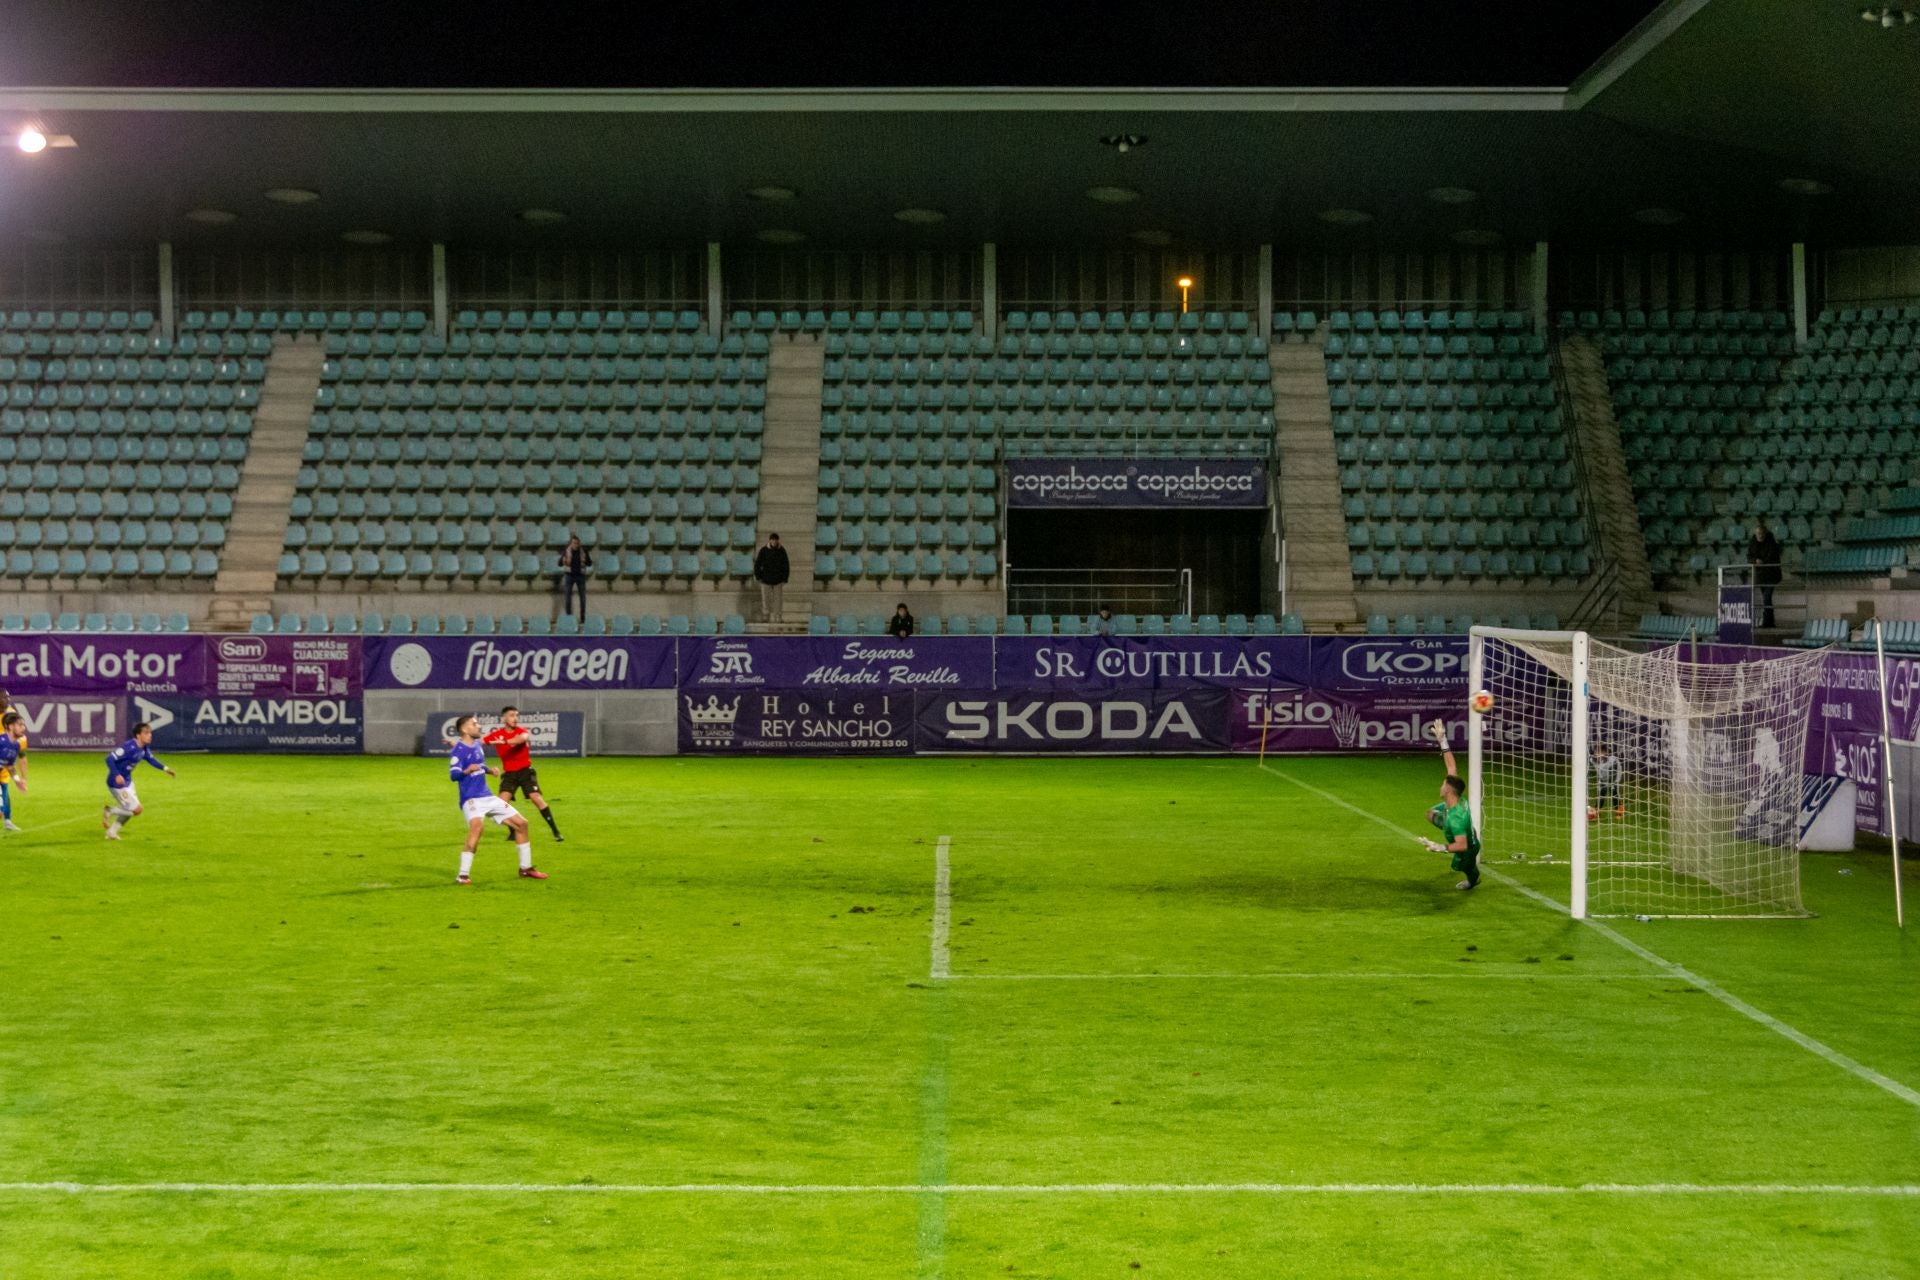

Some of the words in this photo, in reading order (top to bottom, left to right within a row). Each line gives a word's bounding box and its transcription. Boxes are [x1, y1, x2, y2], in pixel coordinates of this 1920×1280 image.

[1012, 466, 1127, 497] copaboca
[1137, 466, 1252, 497] copaboca
[223, 641, 261, 656] Sam
[716, 641, 748, 651] Seguros
[842, 643, 915, 665] Seguros
[1410, 639, 1443, 649] BAR
[0, 643, 51, 678] ral
[64, 645, 182, 678] Motor
[293, 650, 348, 660] CUADERNOS
[464, 641, 629, 687] fibergreen
[711, 652, 752, 673] SAR
[1034, 648, 1085, 678] SR.
[1096, 648, 1273, 678] CUTILLAS
[802, 666, 881, 685] Albadri
[888, 666, 961, 685] Revilla
[127, 681, 177, 693] Palencia
[194, 699, 356, 725] ARAMBOL
[762, 695, 890, 715] Hotel
[761, 720, 796, 737] REY
[802, 719, 893, 738] SANCHO
[945, 701, 1202, 740] SKODA
[1359, 713, 1529, 748] palenia
[40, 735, 116, 746] www.caviti.es
[193, 727, 267, 736] INGENIERIA
[268, 735, 357, 746] www.arambol.es
[742, 740, 788, 748] BANQUETES
[795, 740, 849, 748] COMUNIONES
[851, 739, 868, 747] 979
[869, 739, 881, 747] 72
[882, 739, 895, 747] 53
[895, 739, 909, 747] 00
[1848, 738, 1877, 785] SILOÉ
